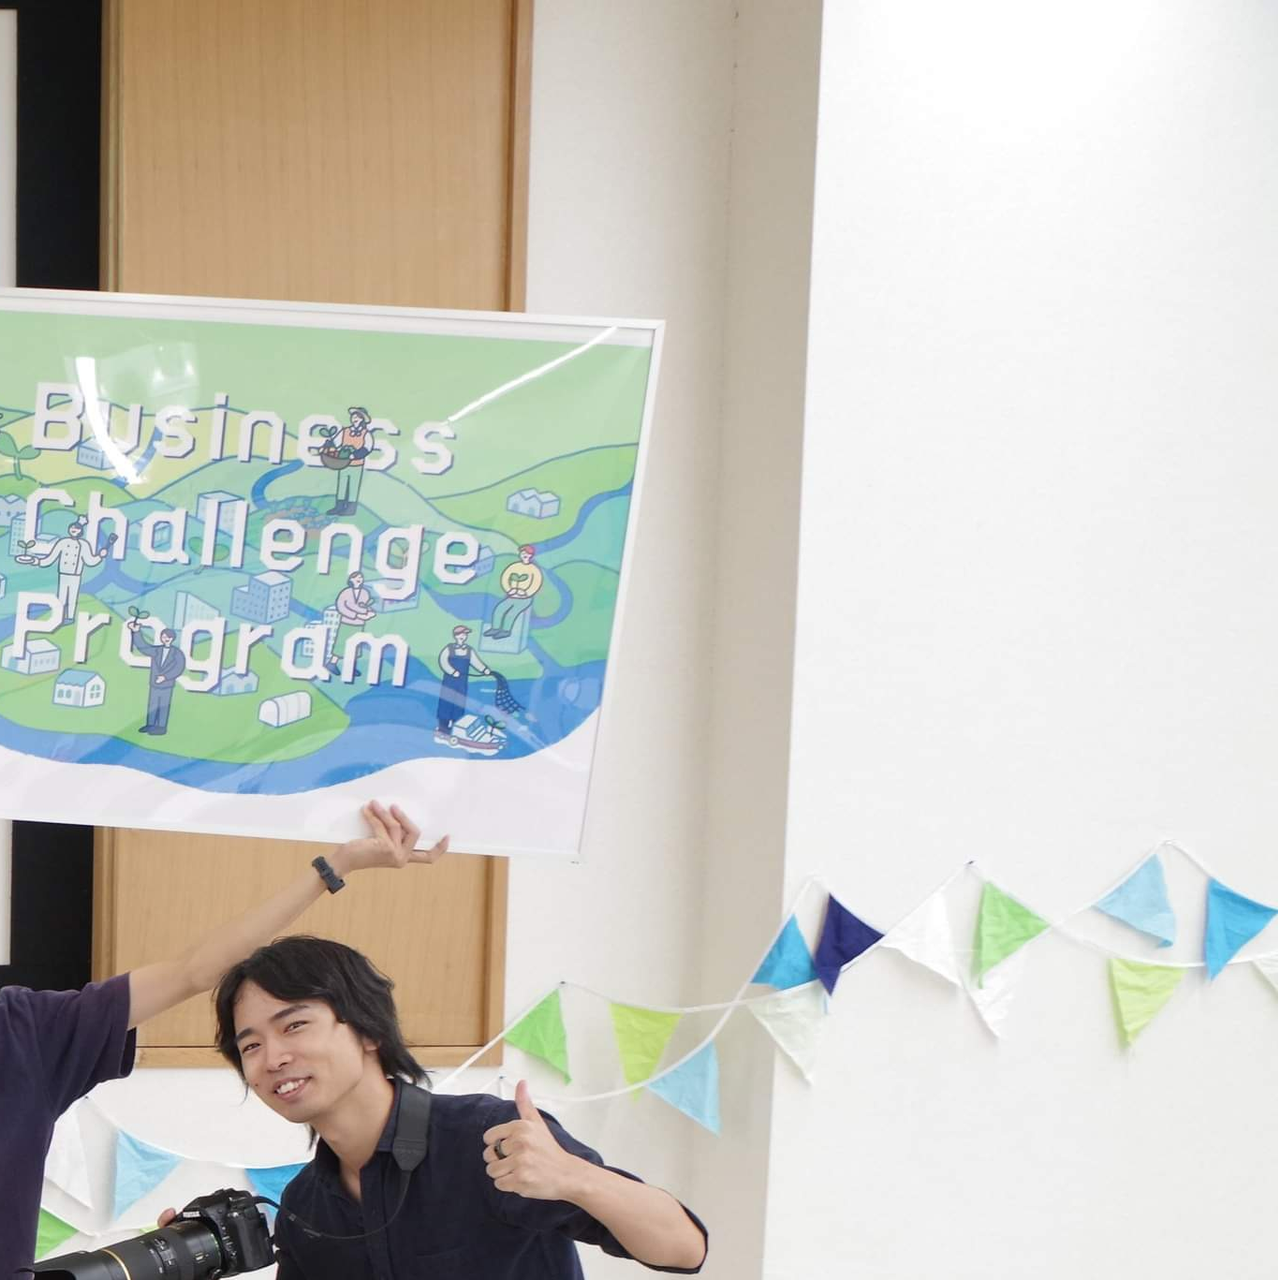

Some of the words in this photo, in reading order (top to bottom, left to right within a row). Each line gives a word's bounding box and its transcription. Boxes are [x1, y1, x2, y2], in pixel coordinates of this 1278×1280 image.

[31, 382, 457, 475] Business
[23, 486, 482, 601] Challenge
[11, 591, 410, 693] Program
